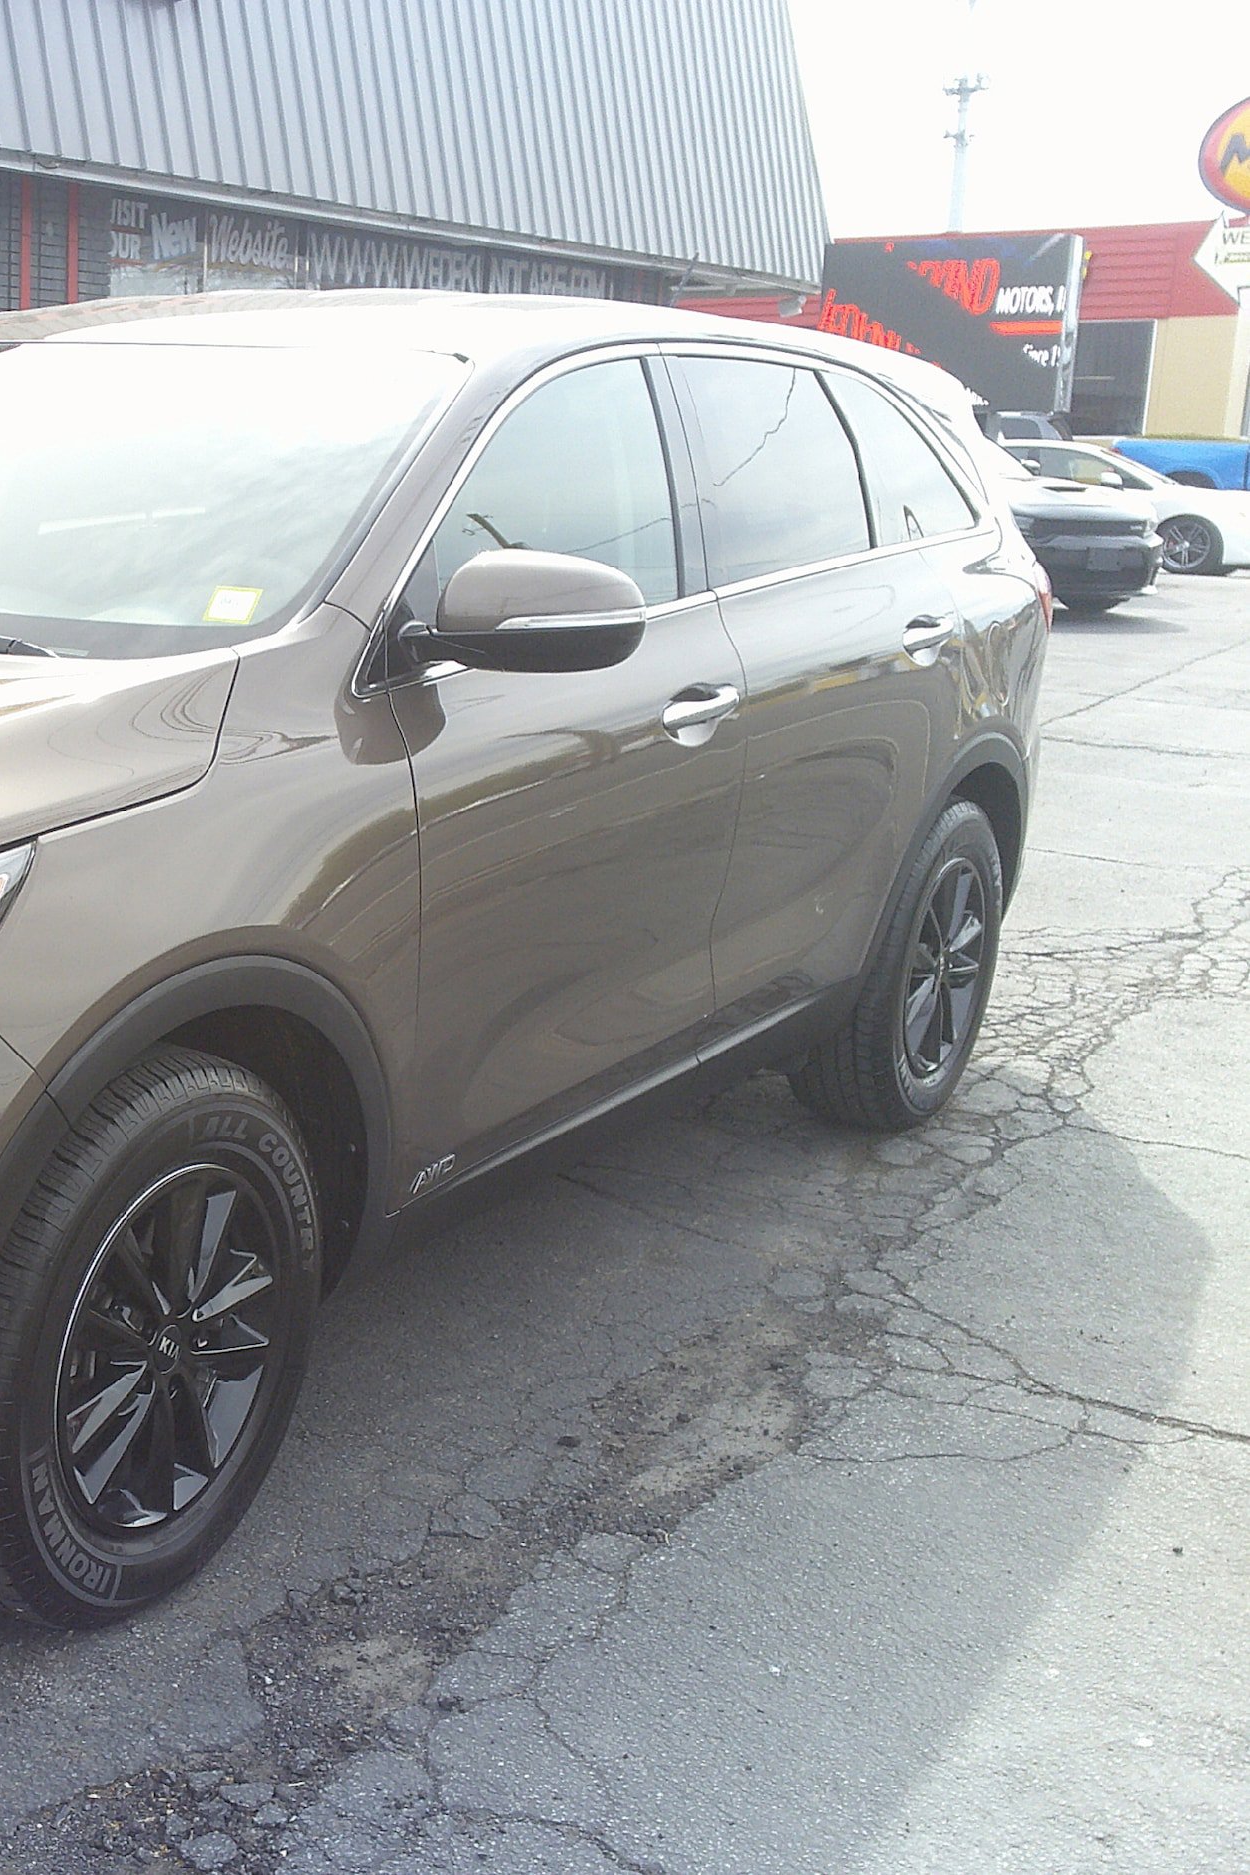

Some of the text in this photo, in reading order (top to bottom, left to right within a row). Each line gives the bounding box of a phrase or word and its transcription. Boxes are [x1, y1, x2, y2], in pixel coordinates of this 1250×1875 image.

[151, 212, 289, 270] New Website
[158, 1335, 180, 1360] KIA
[31, 1462, 111, 1586] IRONMAN
